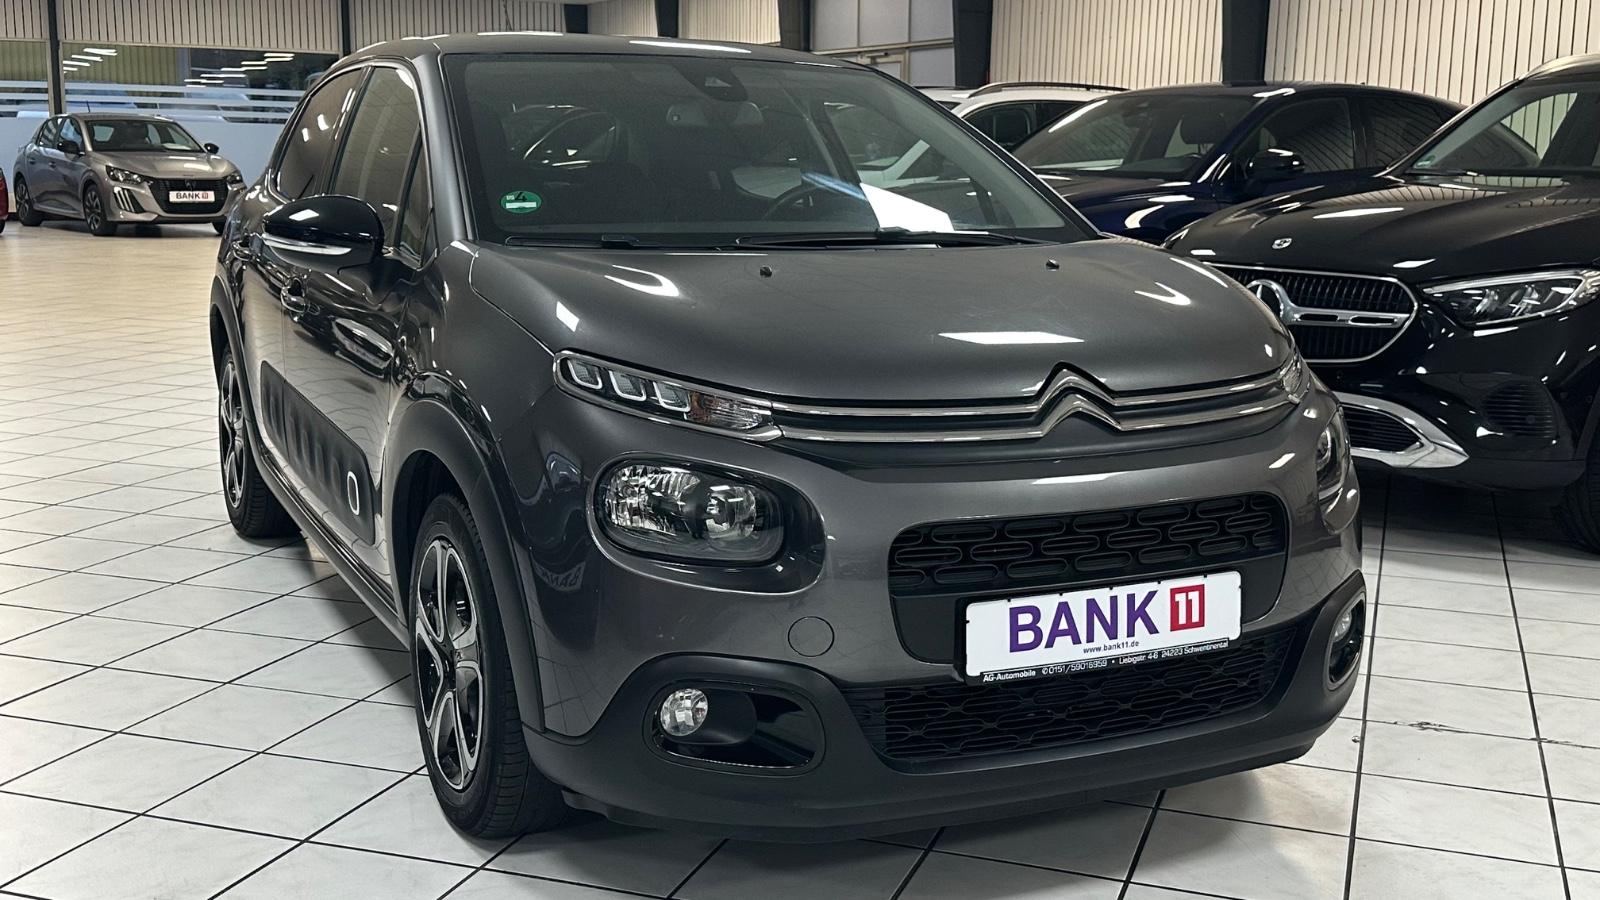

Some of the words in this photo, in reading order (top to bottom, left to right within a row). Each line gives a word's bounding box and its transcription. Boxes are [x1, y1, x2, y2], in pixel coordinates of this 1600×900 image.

[1009, 590, 1159, 653] BANK
[1175, 592, 1200, 626] 11
[1083, 640, 1139, 654] www.bank11.de
[983, 669, 1036, 682] AG-Automobile
